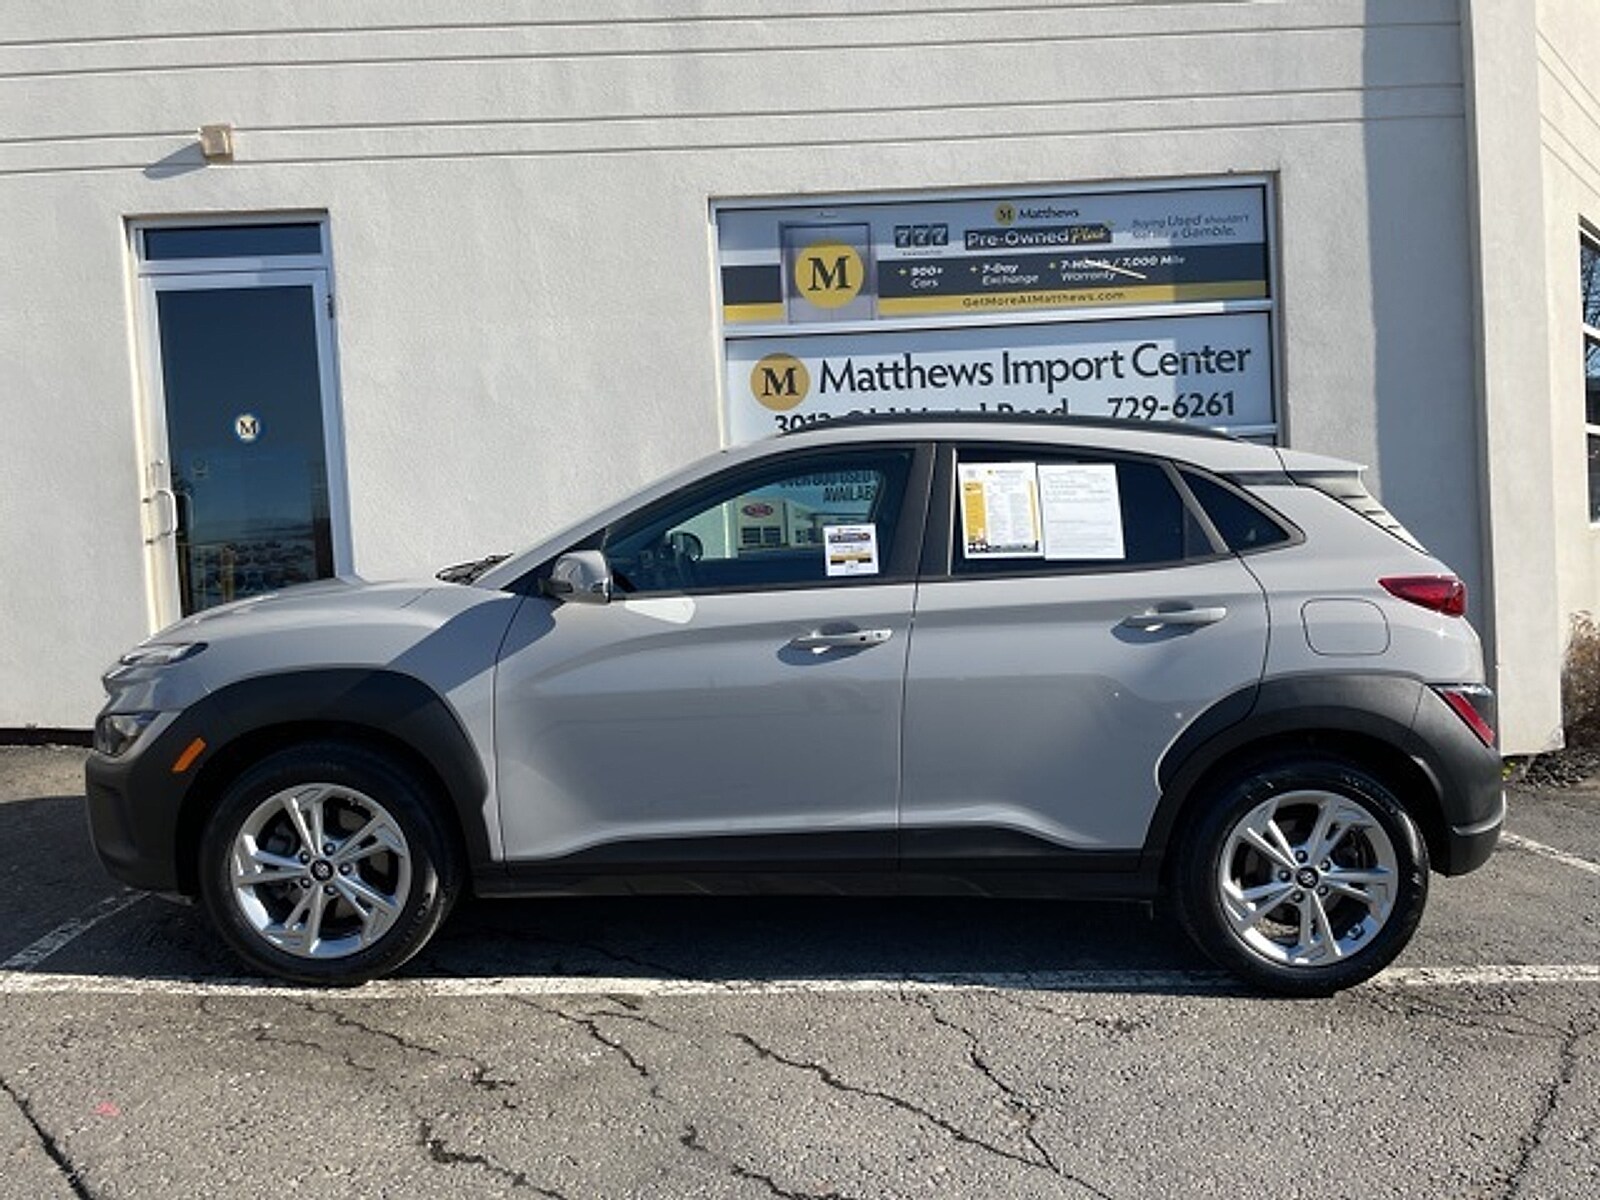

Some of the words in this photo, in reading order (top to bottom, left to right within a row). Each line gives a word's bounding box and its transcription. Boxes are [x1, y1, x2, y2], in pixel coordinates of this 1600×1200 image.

[1018, 206, 1079, 219] Matthews
[1167, 214, 1202, 227] Used
[967, 227, 1068, 247] Pre-Owned
[808, 255, 851, 291] M
[982, 262, 1018, 275] 7-Day
[910, 277, 939, 288] Cars
[982, 273, 1039, 286] Exchange
[1061, 270, 1117, 282] Warranty
[963, 292, 1124, 307] GetMoreAtMatthews.com
[761, 367, 797, 396] M
[819, 353, 994, 393] Matthews
[1002, 350, 1124, 394] Import
[1131, 342, 1251, 377] Center
[1107, 390, 1235, 421] 729-6261
[239, 419, 257, 435] M
